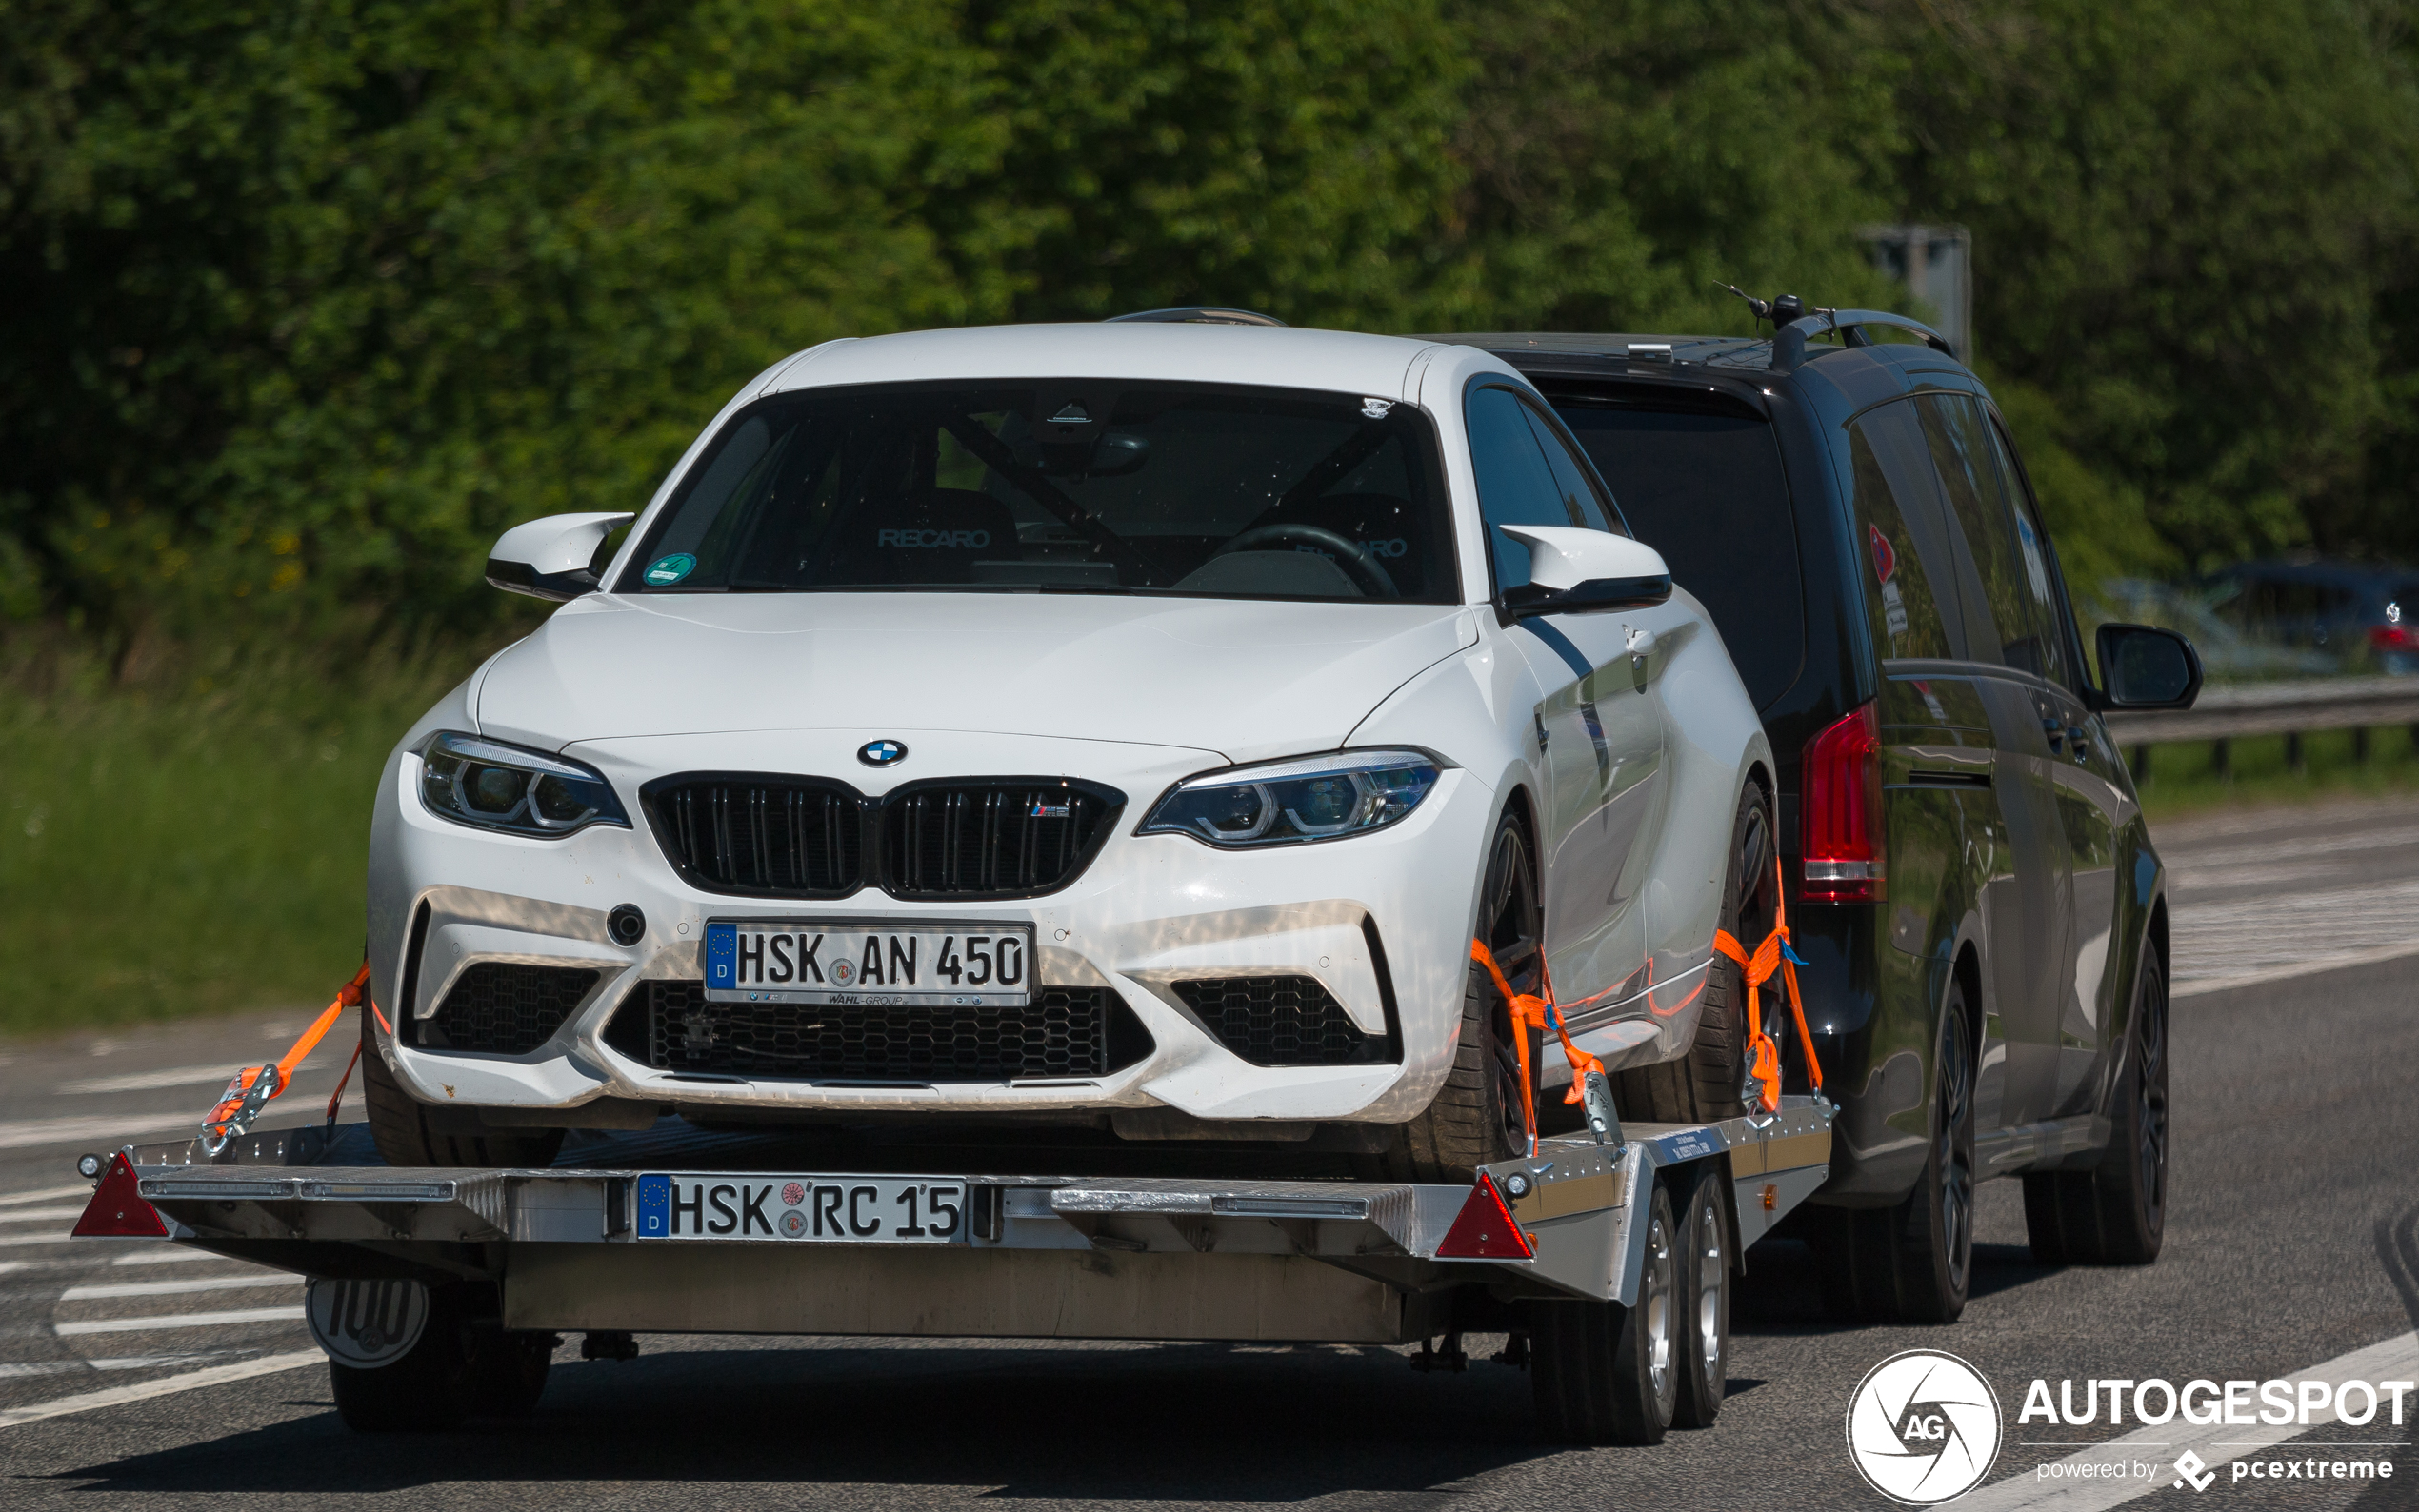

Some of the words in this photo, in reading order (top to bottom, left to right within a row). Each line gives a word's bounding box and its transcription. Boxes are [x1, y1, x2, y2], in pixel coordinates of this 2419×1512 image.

[877, 528, 990, 548] RECARO
[667, 558, 684, 571] 4
[738, 933, 825, 983] HSK
[858, 935, 917, 985] AN
[936, 936, 1022, 986] 450
[717, 964, 728, 978] D
[670, 1184, 774, 1235] HSK
[813, 1185, 881, 1237] RC
[895, 1186, 959, 1238] 15
[649, 1215, 659, 1230] D
